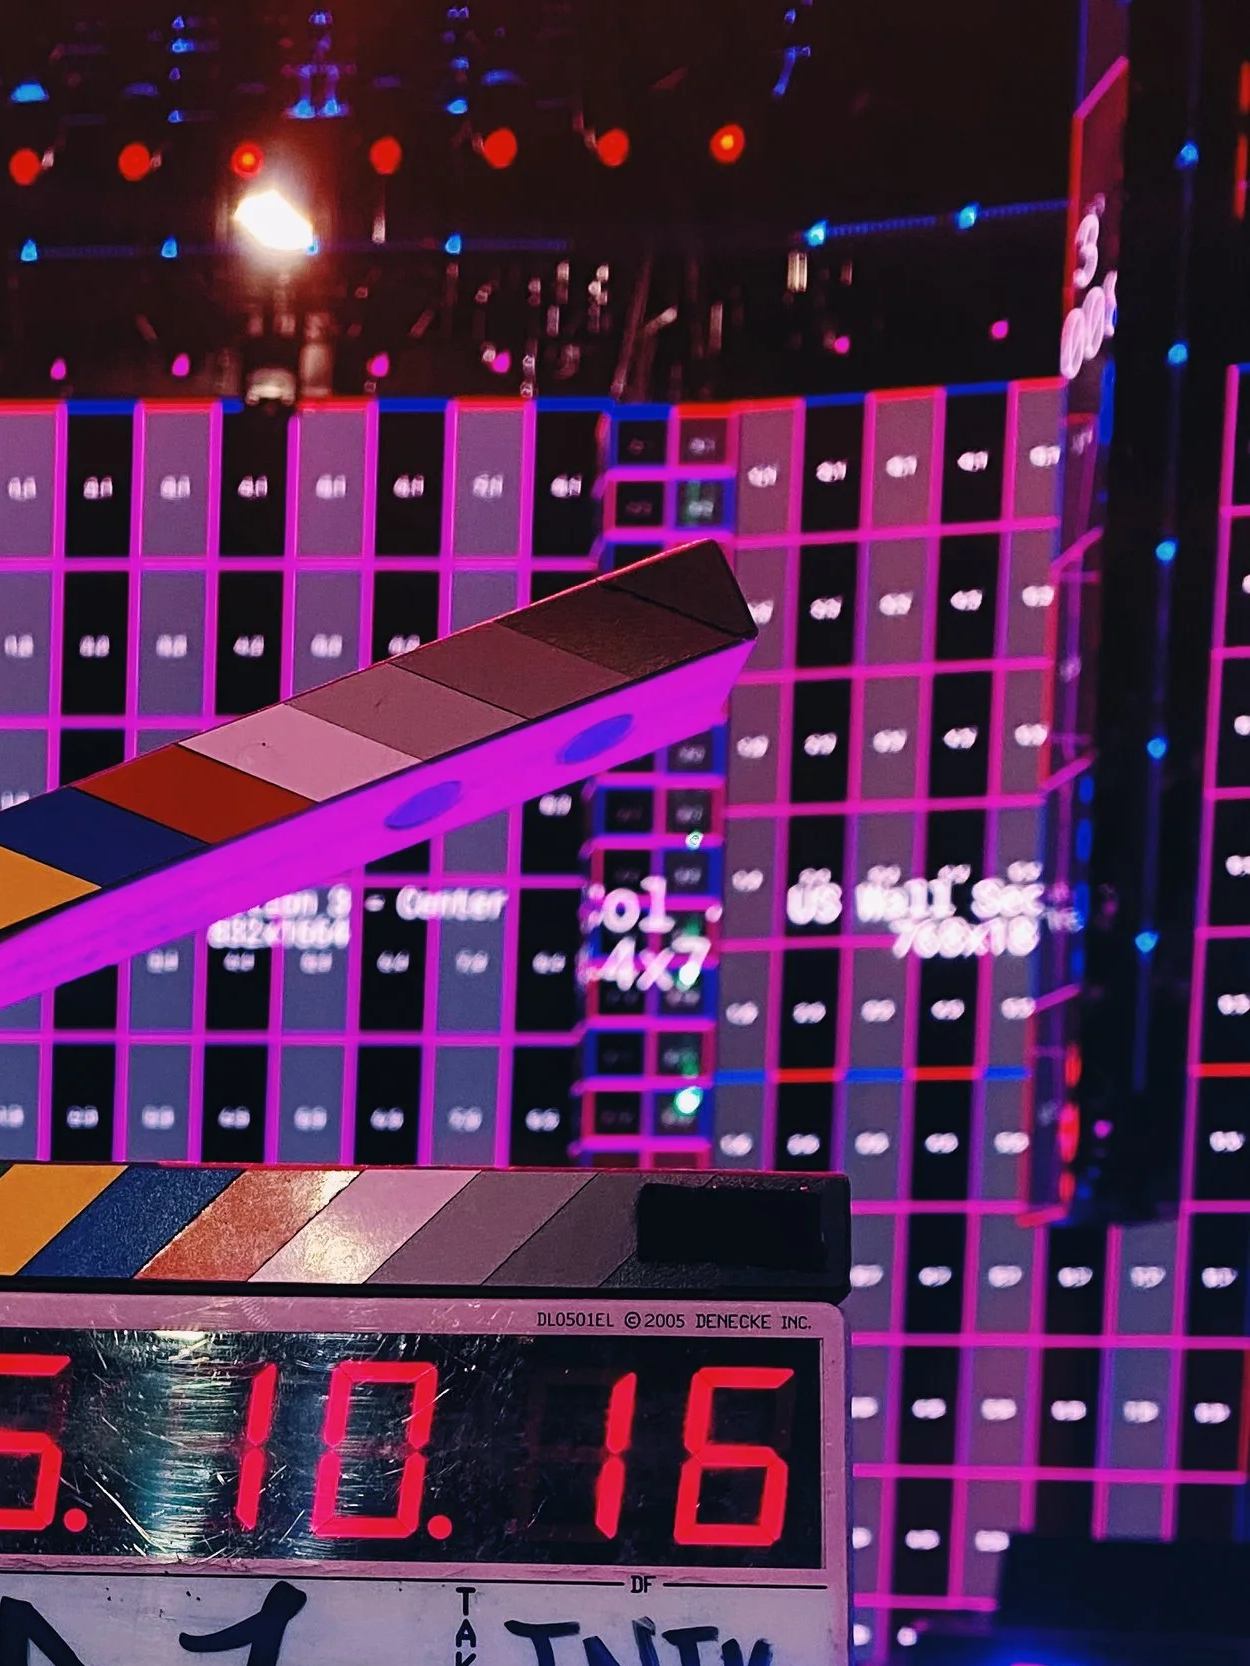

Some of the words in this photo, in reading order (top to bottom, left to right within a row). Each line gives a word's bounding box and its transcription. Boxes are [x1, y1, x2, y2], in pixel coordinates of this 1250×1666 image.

[695, 1313, 772, 1330] DENECKE
[781, 1315, 812, 1330] INC.
[630, 1575, 656, 1594] DF
